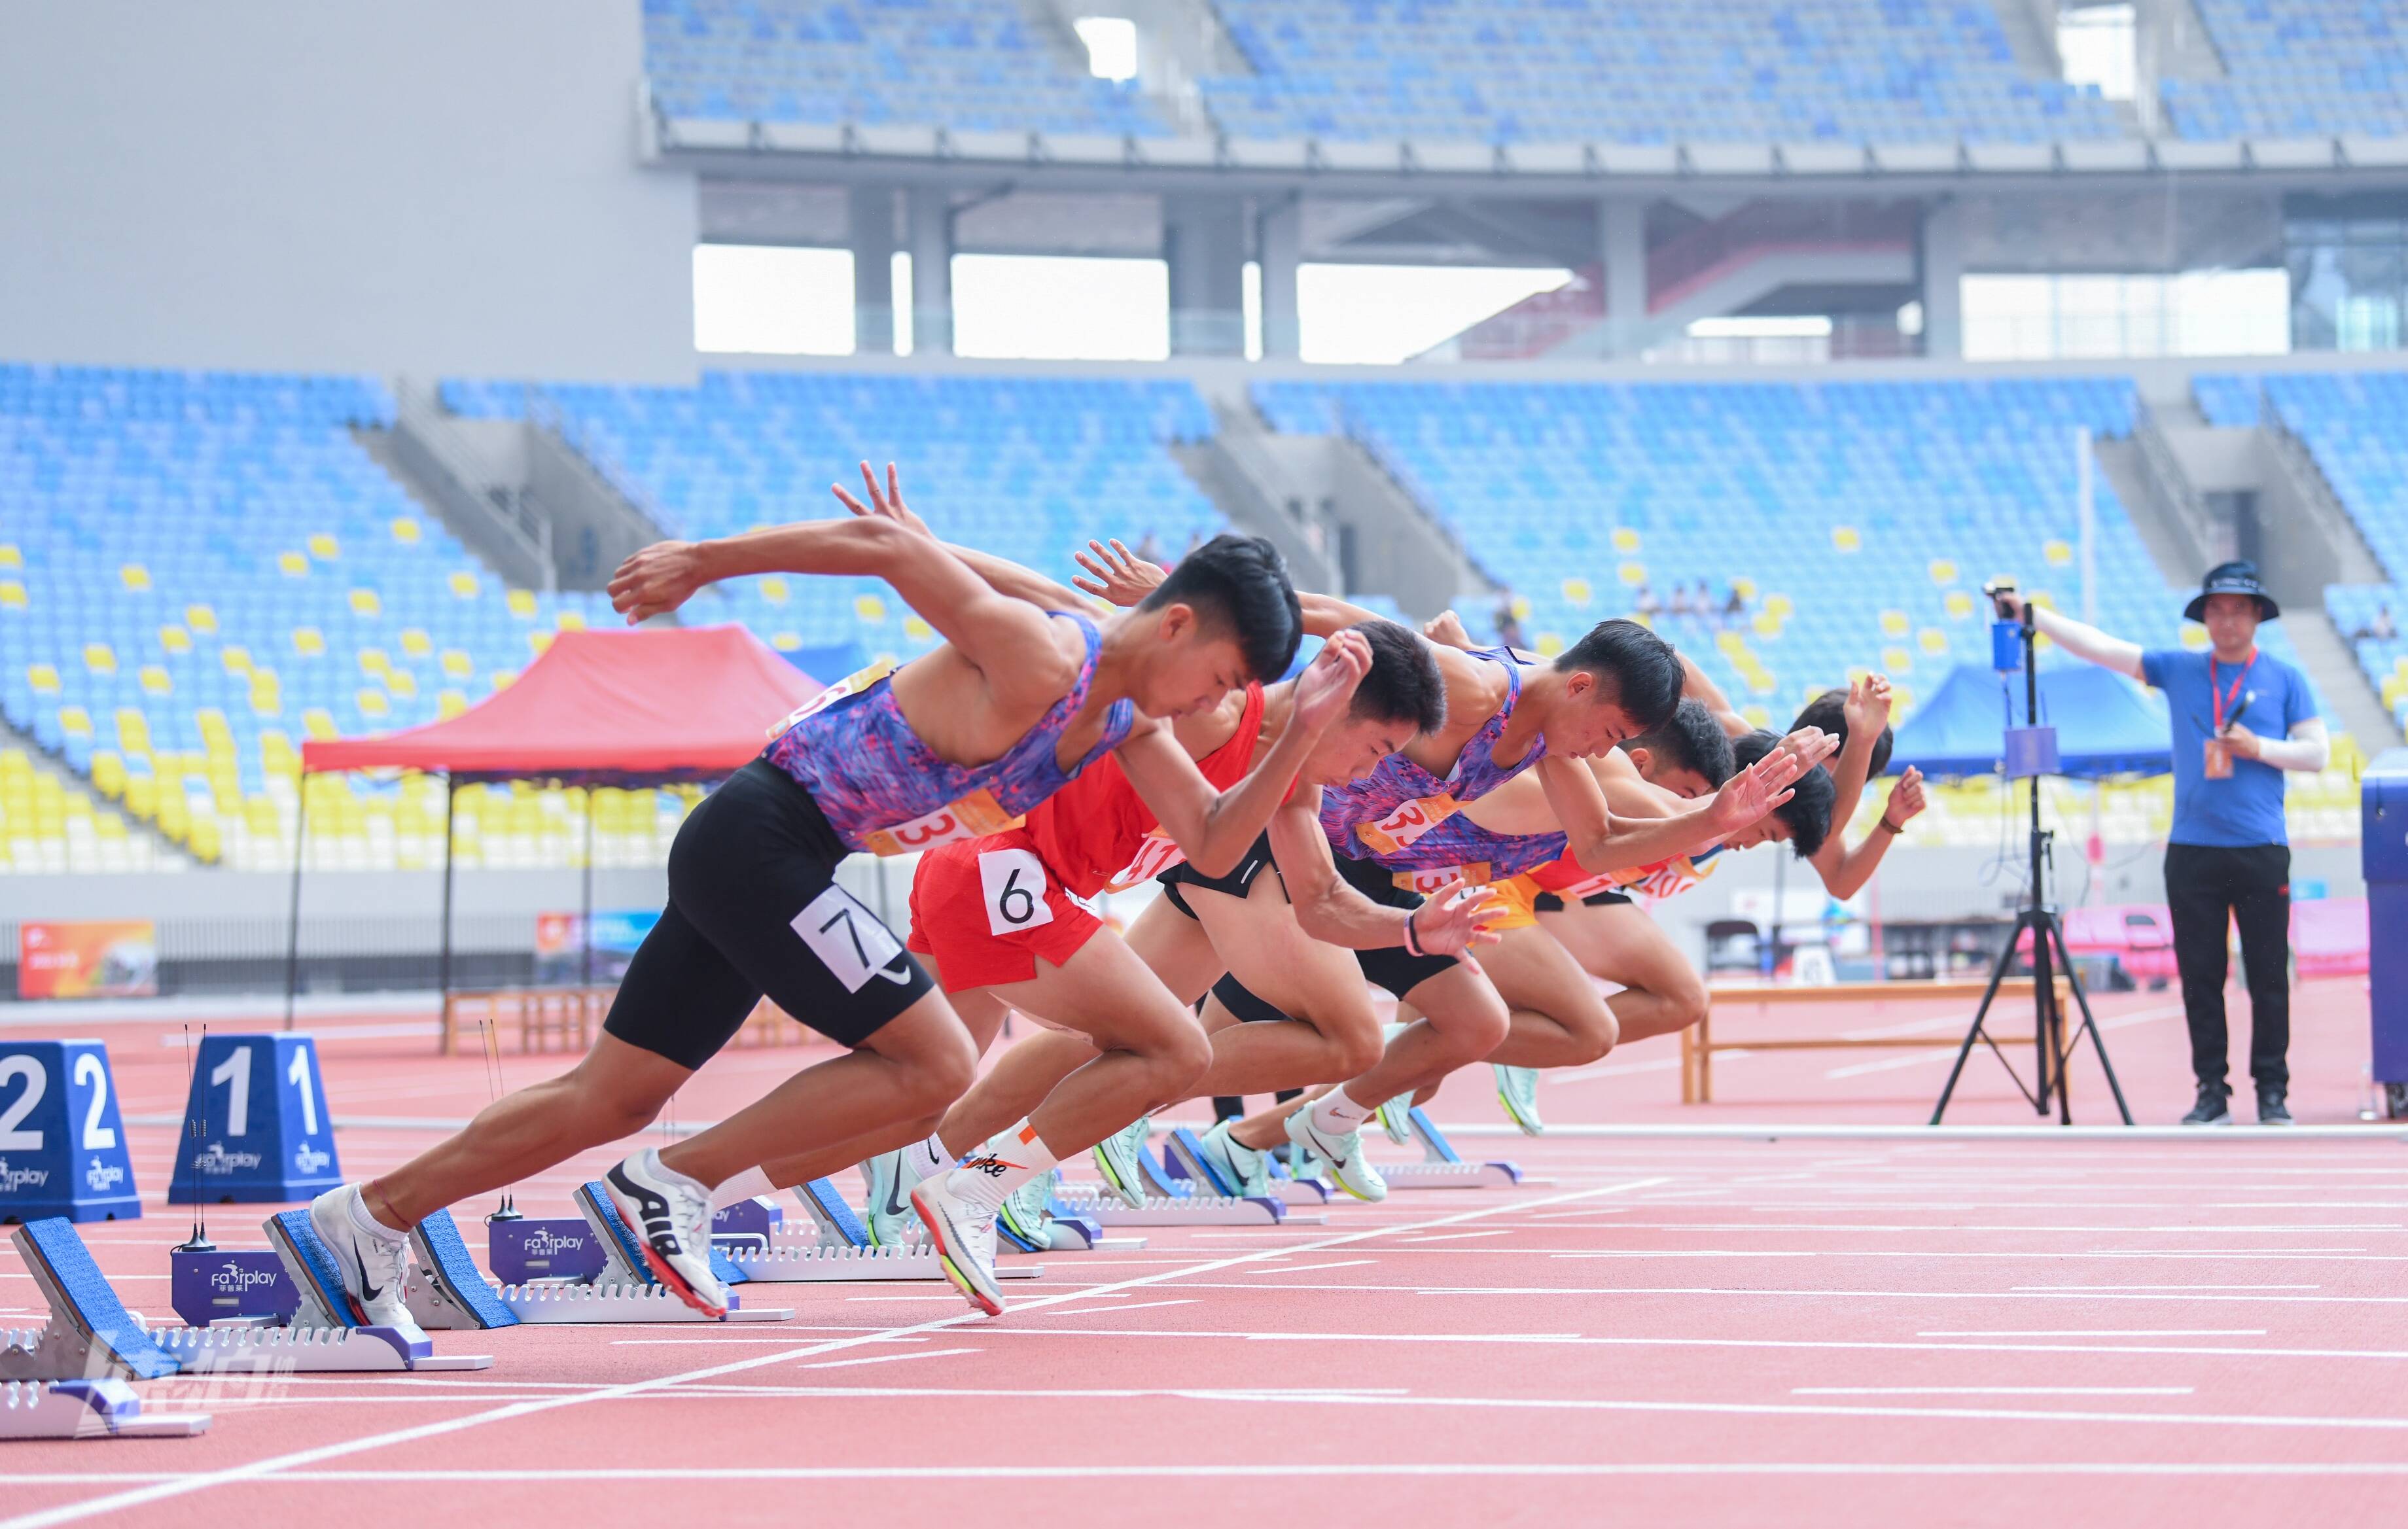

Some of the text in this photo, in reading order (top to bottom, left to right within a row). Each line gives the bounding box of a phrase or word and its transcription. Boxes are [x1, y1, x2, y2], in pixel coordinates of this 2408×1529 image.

[895, 814, 973, 845] 3
[1127, 840, 1188, 881] 41
[999, 868, 1035, 924] 6
[819, 908, 872, 970] 7
[0, 1053, 47, 1151] 2
[73, 1052, 116, 1150] 2
[211, 1046, 252, 1136] 1
[287, 1044, 319, 1136] 1
